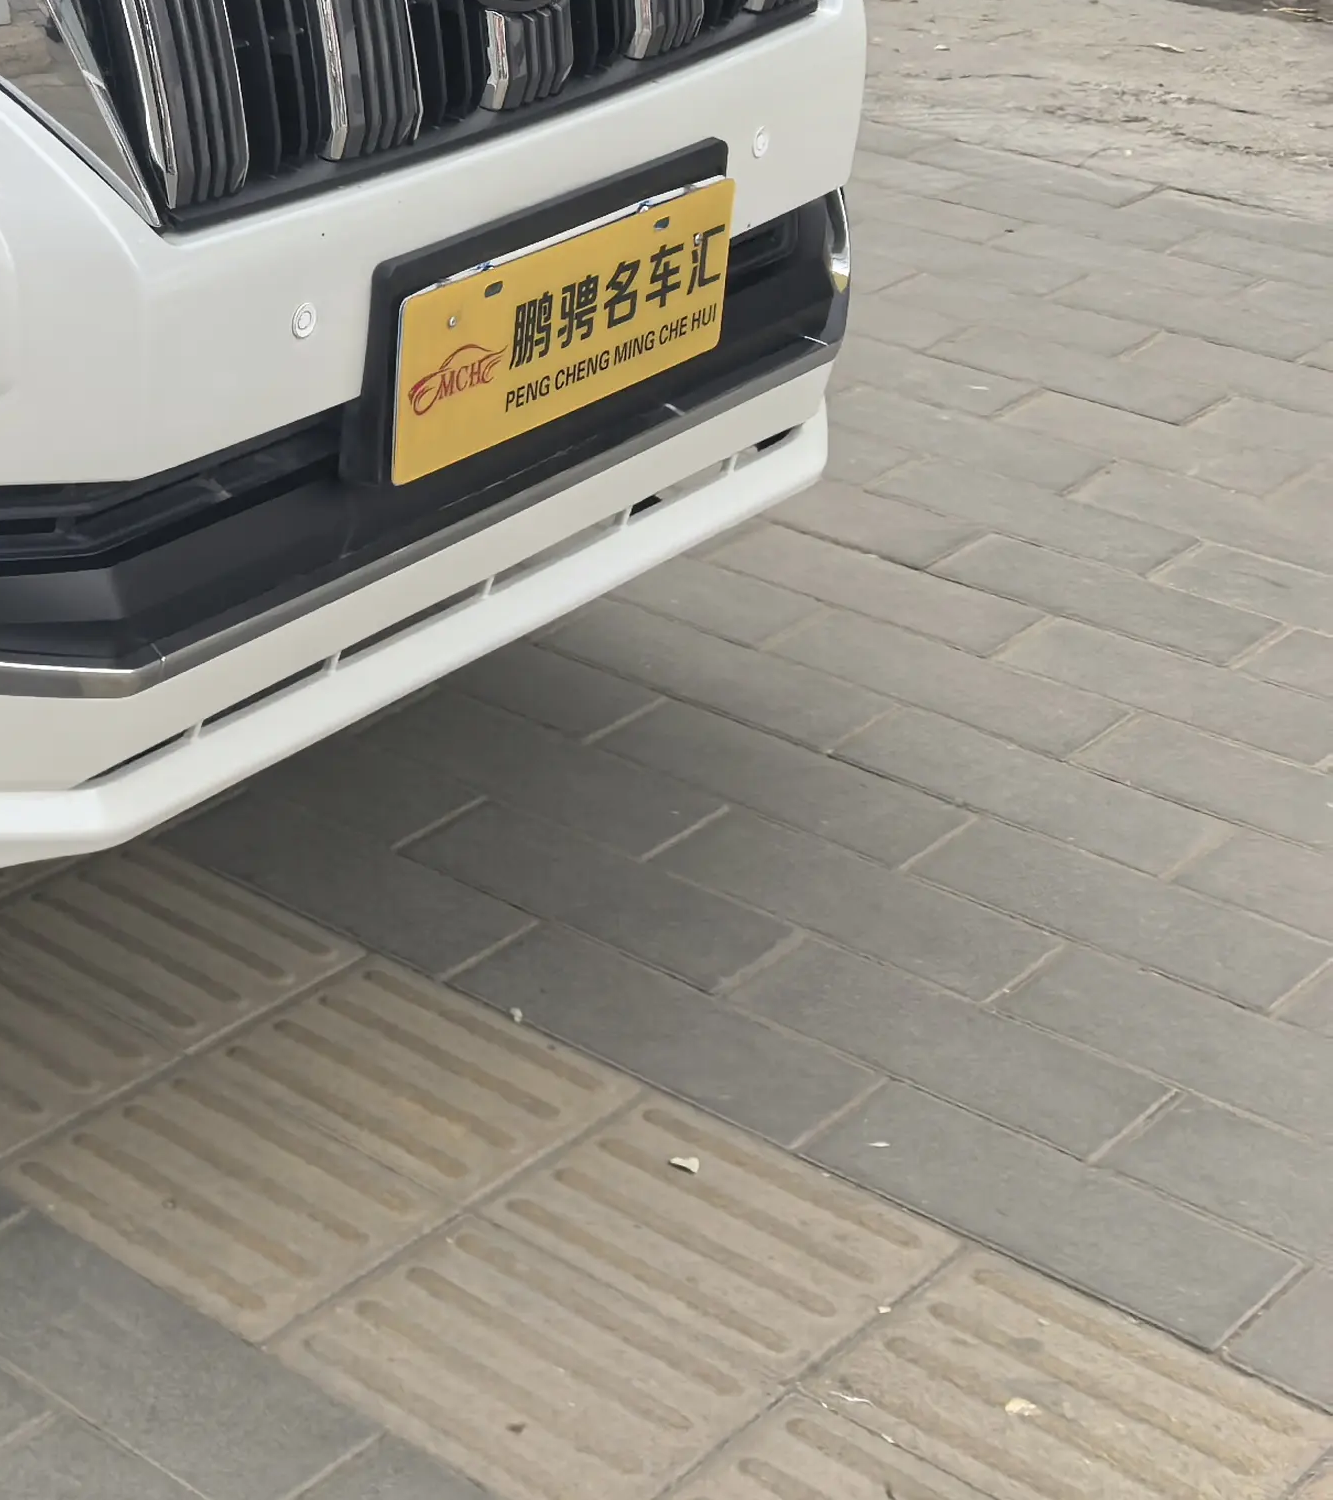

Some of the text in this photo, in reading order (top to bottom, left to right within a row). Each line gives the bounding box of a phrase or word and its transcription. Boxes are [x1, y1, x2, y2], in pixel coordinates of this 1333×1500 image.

[504, 302, 718, 414] PENG CHENG MING CHE HUI
[508, 223, 727, 371] 鹏骋名车汇
